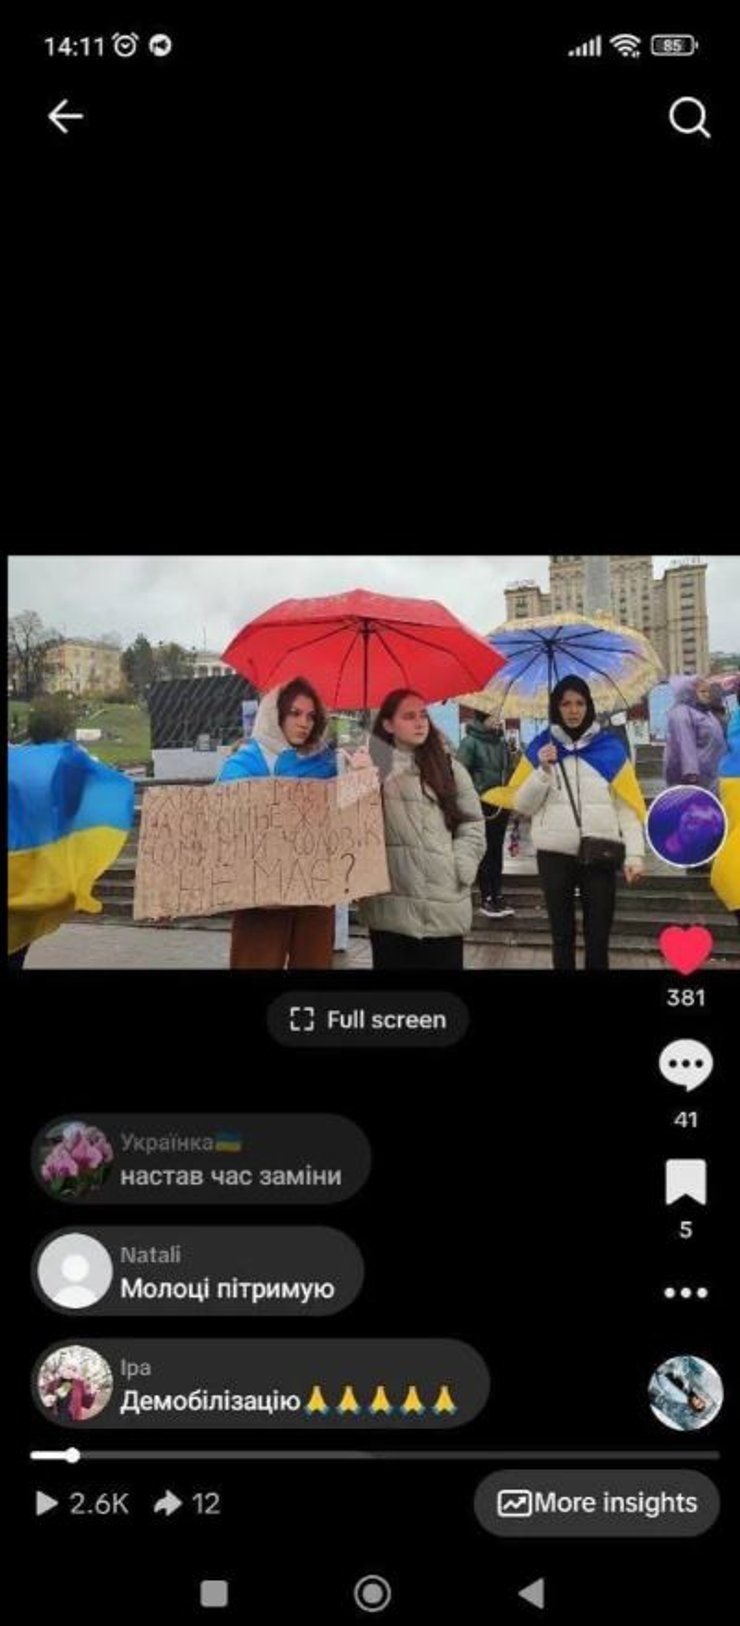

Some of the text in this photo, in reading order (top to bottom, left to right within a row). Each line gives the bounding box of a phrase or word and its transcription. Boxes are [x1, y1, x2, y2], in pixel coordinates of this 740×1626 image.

[45, 37, 105, 57] 14:11
[663, 39, 682, 52] 85
[177, 852, 356, 911] НЕ МАЄ?
[667, 988, 705, 1007] 381
[328, 1009, 447, 1029] Full screen
[674, 1111, 697, 1128] 41
[120, 1132, 213, 1154] Українка
[120, 1164, 342, 1186] настав час заміни
[680, 1220, 693, 1239] 5
[120, 1244, 181, 1264] Natali
[120, 1277, 335, 1304] Молоці пітримую
[120, 1388, 300, 1415] Демобілізацію
[70, 1492, 129, 1515] 2.6K
[192, 1492, 220, 1514] 12
[534, 1490, 698, 1518] More insights
